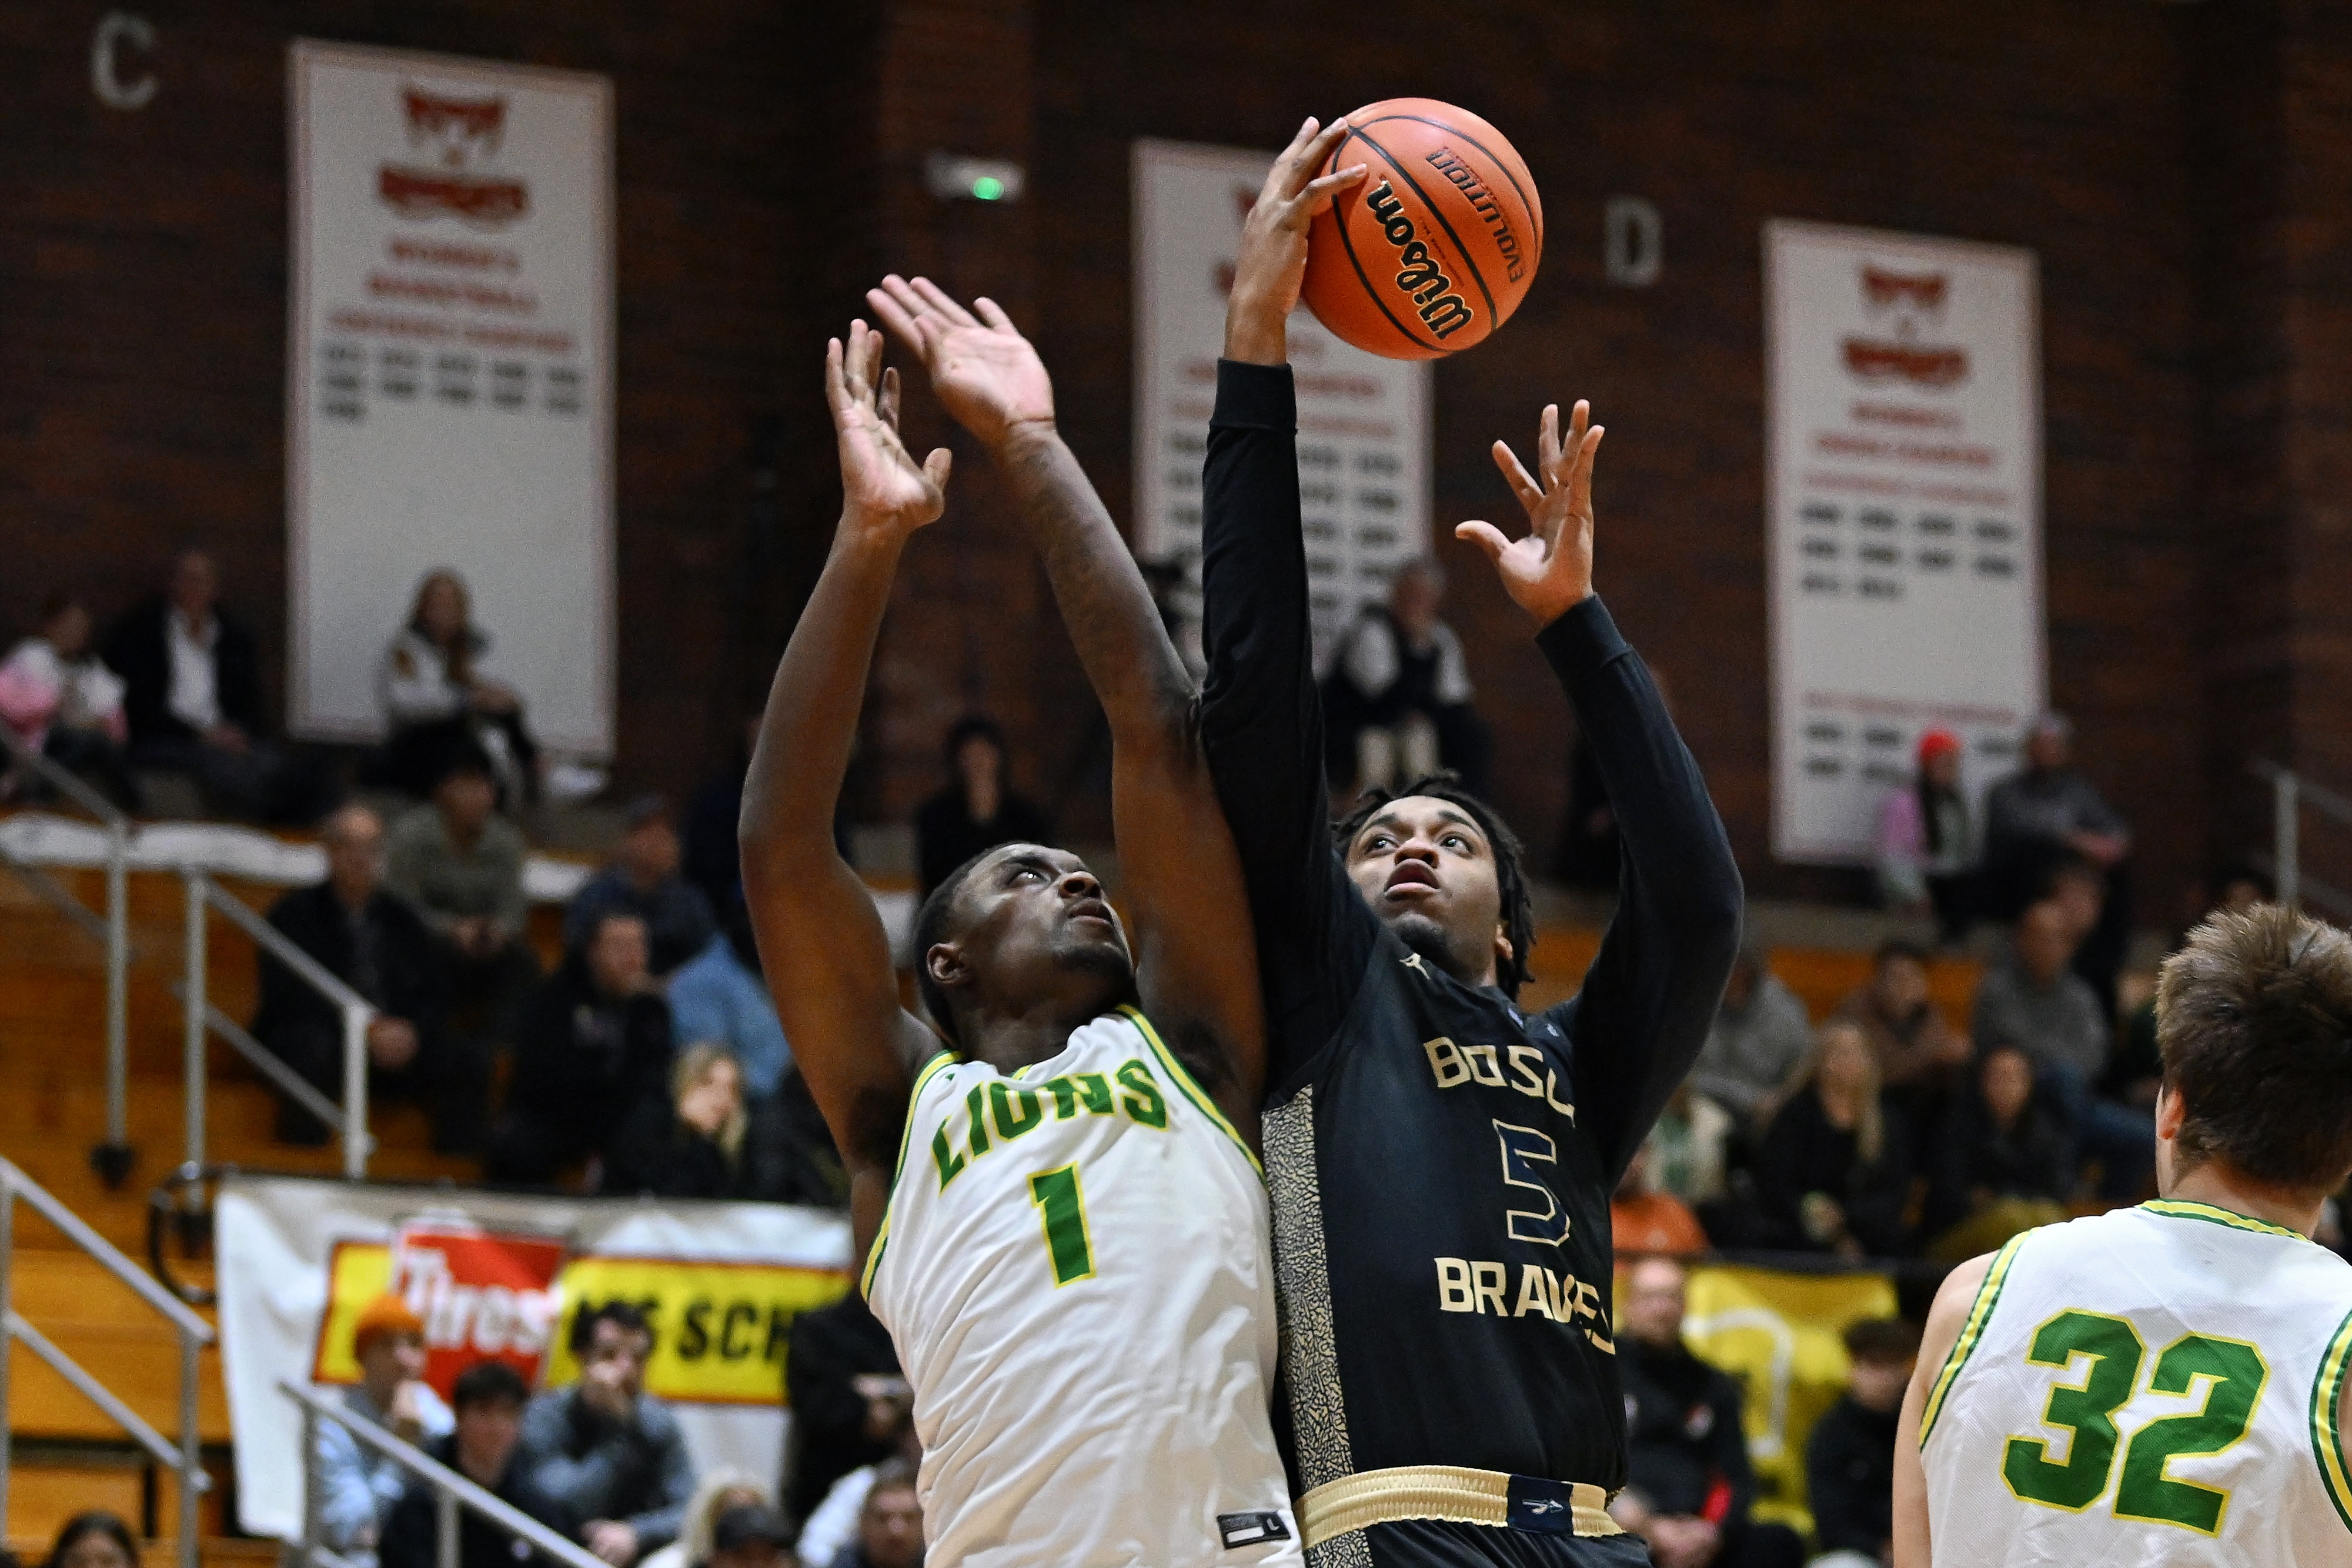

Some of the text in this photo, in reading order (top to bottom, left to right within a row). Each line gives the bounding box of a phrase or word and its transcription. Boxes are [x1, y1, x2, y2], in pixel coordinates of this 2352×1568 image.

[91, 12, 158, 109] C
[1367, 180, 1474, 340] Wilson
[1428, 151, 1525, 283] EVOLUTION
[1605, 197, 1662, 287] D
[932, 1058, 1168, 1193] LIONS
[1424, 1037, 1575, 1126] BOSC
[1027, 1161, 1097, 1289] 1
[1492, 1118, 1571, 1247] 5
[677, 1298, 791, 1363] SCH
[1999, 1307, 2271, 1539] 32
